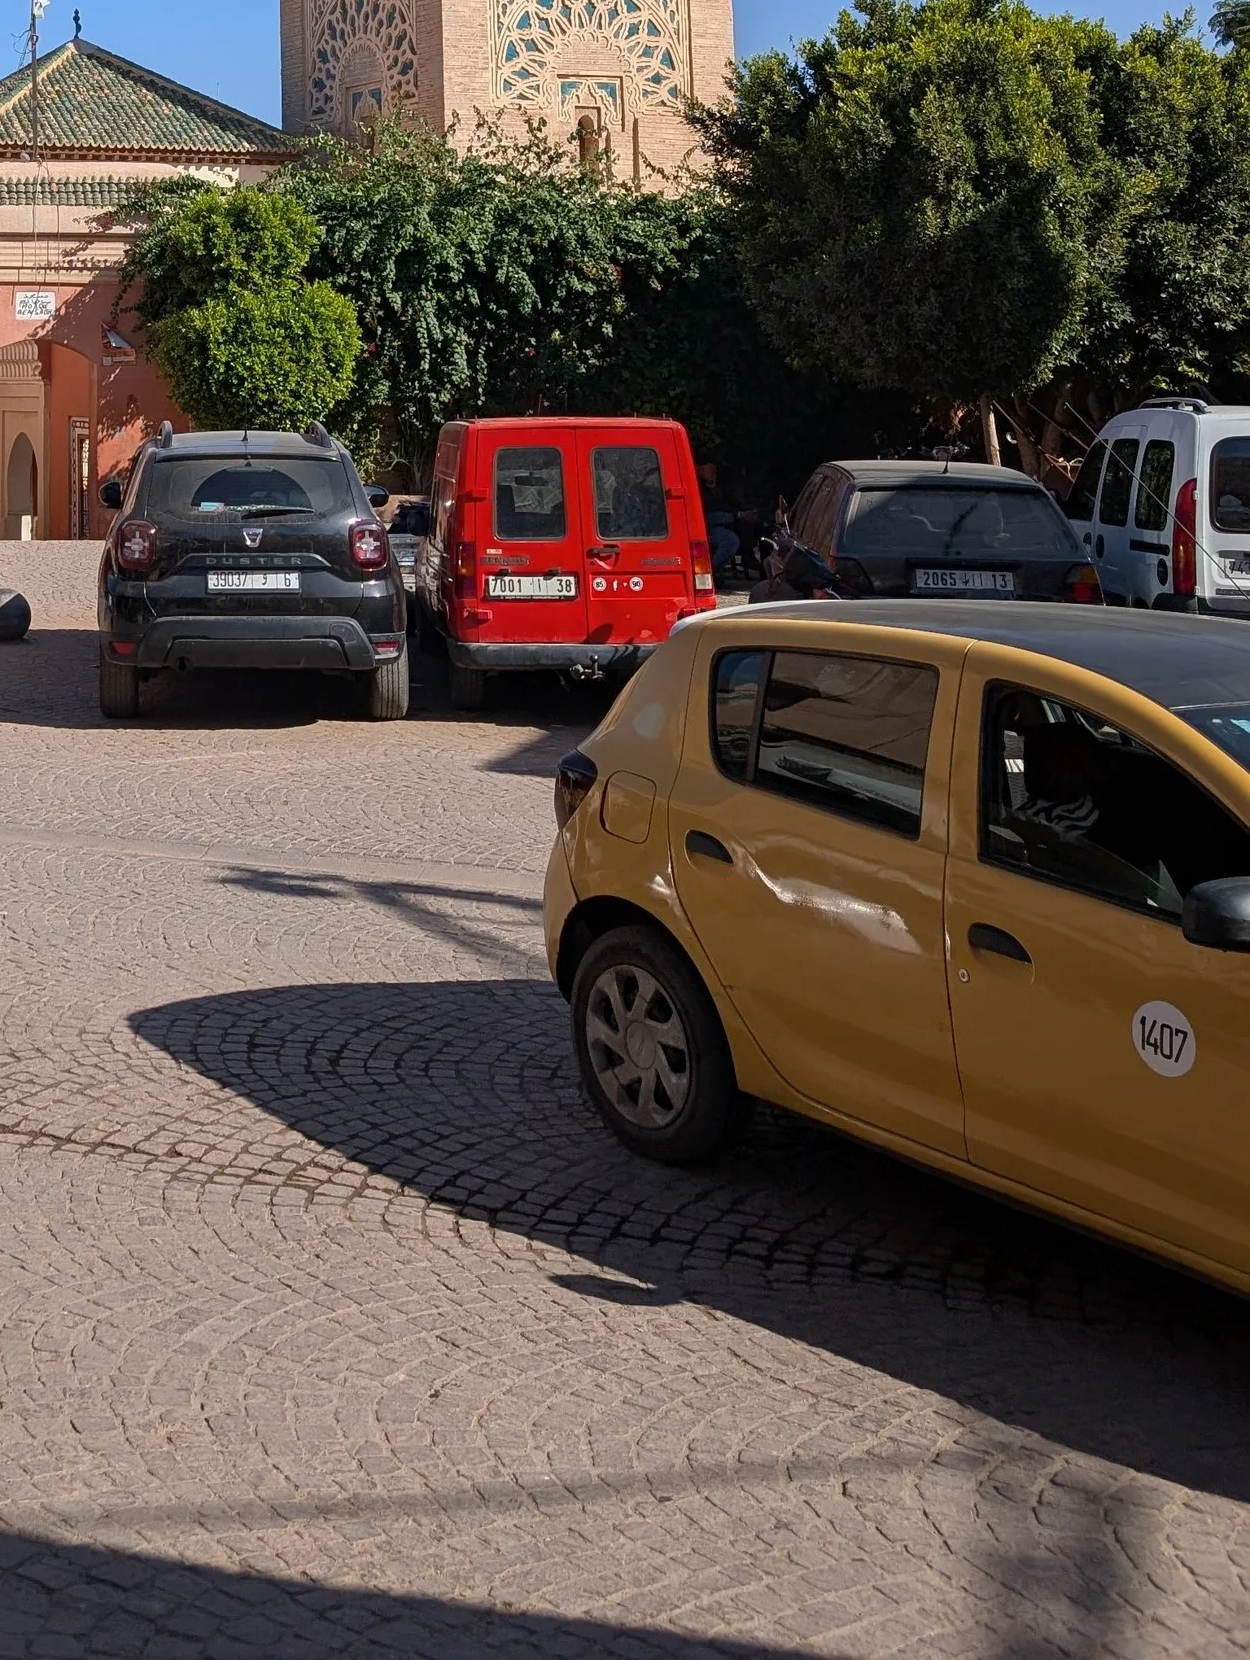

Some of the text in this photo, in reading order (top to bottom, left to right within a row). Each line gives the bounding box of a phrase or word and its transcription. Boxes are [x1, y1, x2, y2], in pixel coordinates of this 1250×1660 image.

[206, 557, 302, 565] DUSTER
[212, 572, 248, 587] 39037
[284, 572, 292, 587] 6
[491, 578, 522, 593] 7001
[557, 579, 572, 593] 38
[923, 572, 957, 587] 2065
[991, 573, 1008, 588] 13
[1140, 1016, 1188, 1063] 1407
